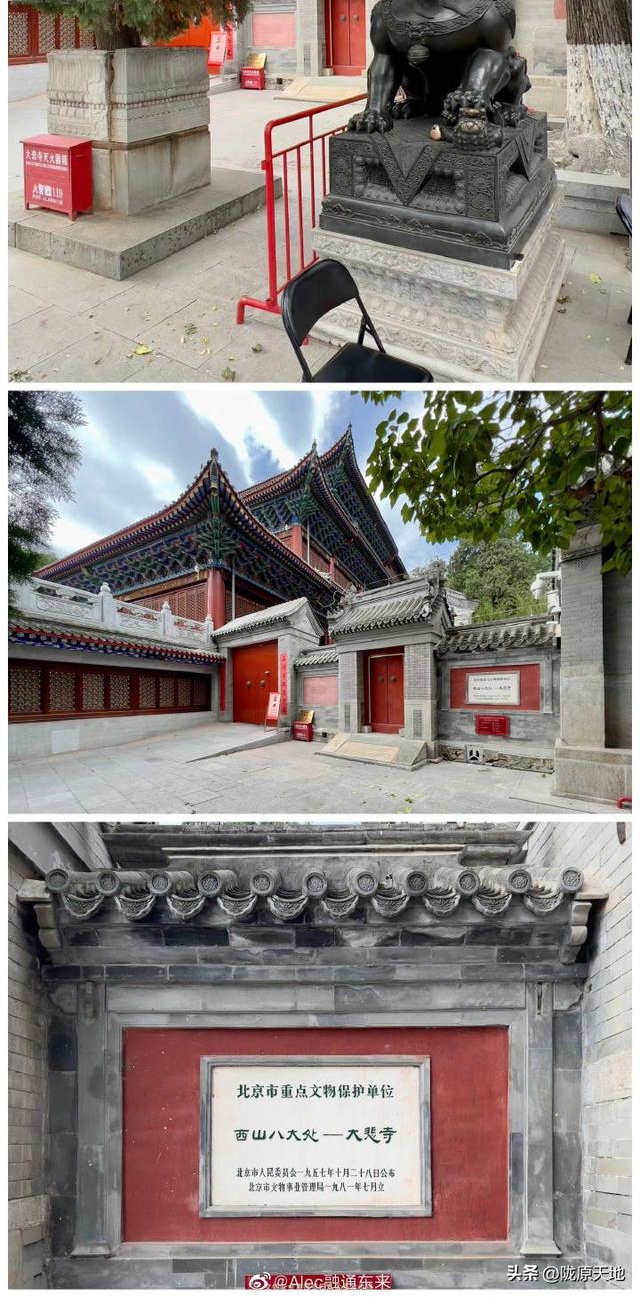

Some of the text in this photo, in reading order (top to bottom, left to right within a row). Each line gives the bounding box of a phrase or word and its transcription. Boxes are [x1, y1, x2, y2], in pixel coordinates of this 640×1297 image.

[237, 1084, 394, 1099] 北京市重点文物保护单位
[237, 1167, 395, 1178] 北京市人民委员会一九五七年十月二十八日公布
[248, 1181, 385, 1192] 北京市文物事业管理局一九八一年七月立
